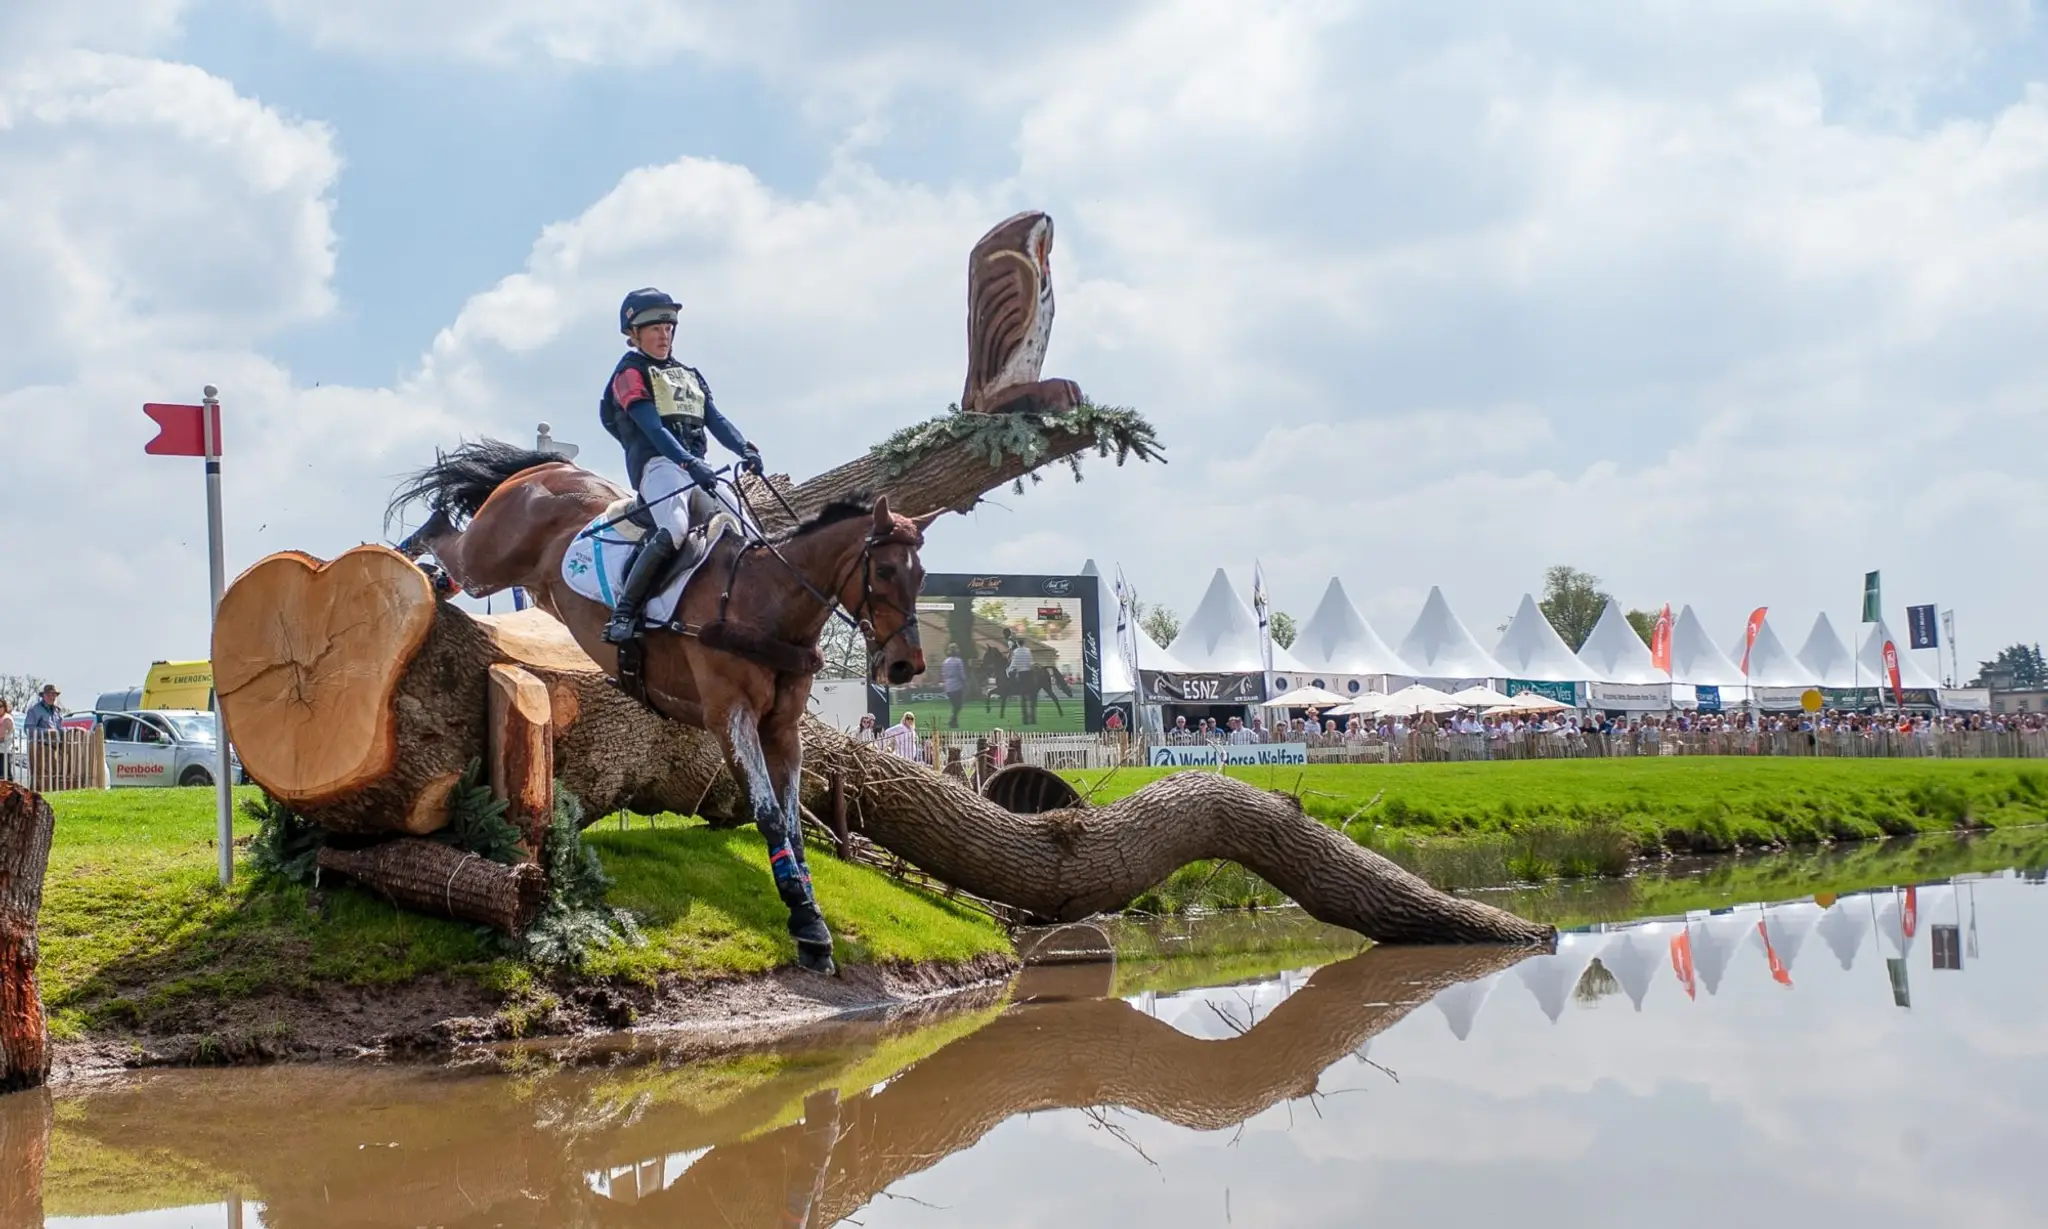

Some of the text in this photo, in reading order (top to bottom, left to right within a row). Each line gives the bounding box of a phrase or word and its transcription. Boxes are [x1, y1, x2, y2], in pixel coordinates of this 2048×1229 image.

[173, 674, 212, 684] EMERGENC
[1183, 680, 1219, 699] ESNZ
[1179, 750, 1216, 766] World
[1258, 748, 1304, 765] Welfare
[117, 764, 164, 773] Penbode
